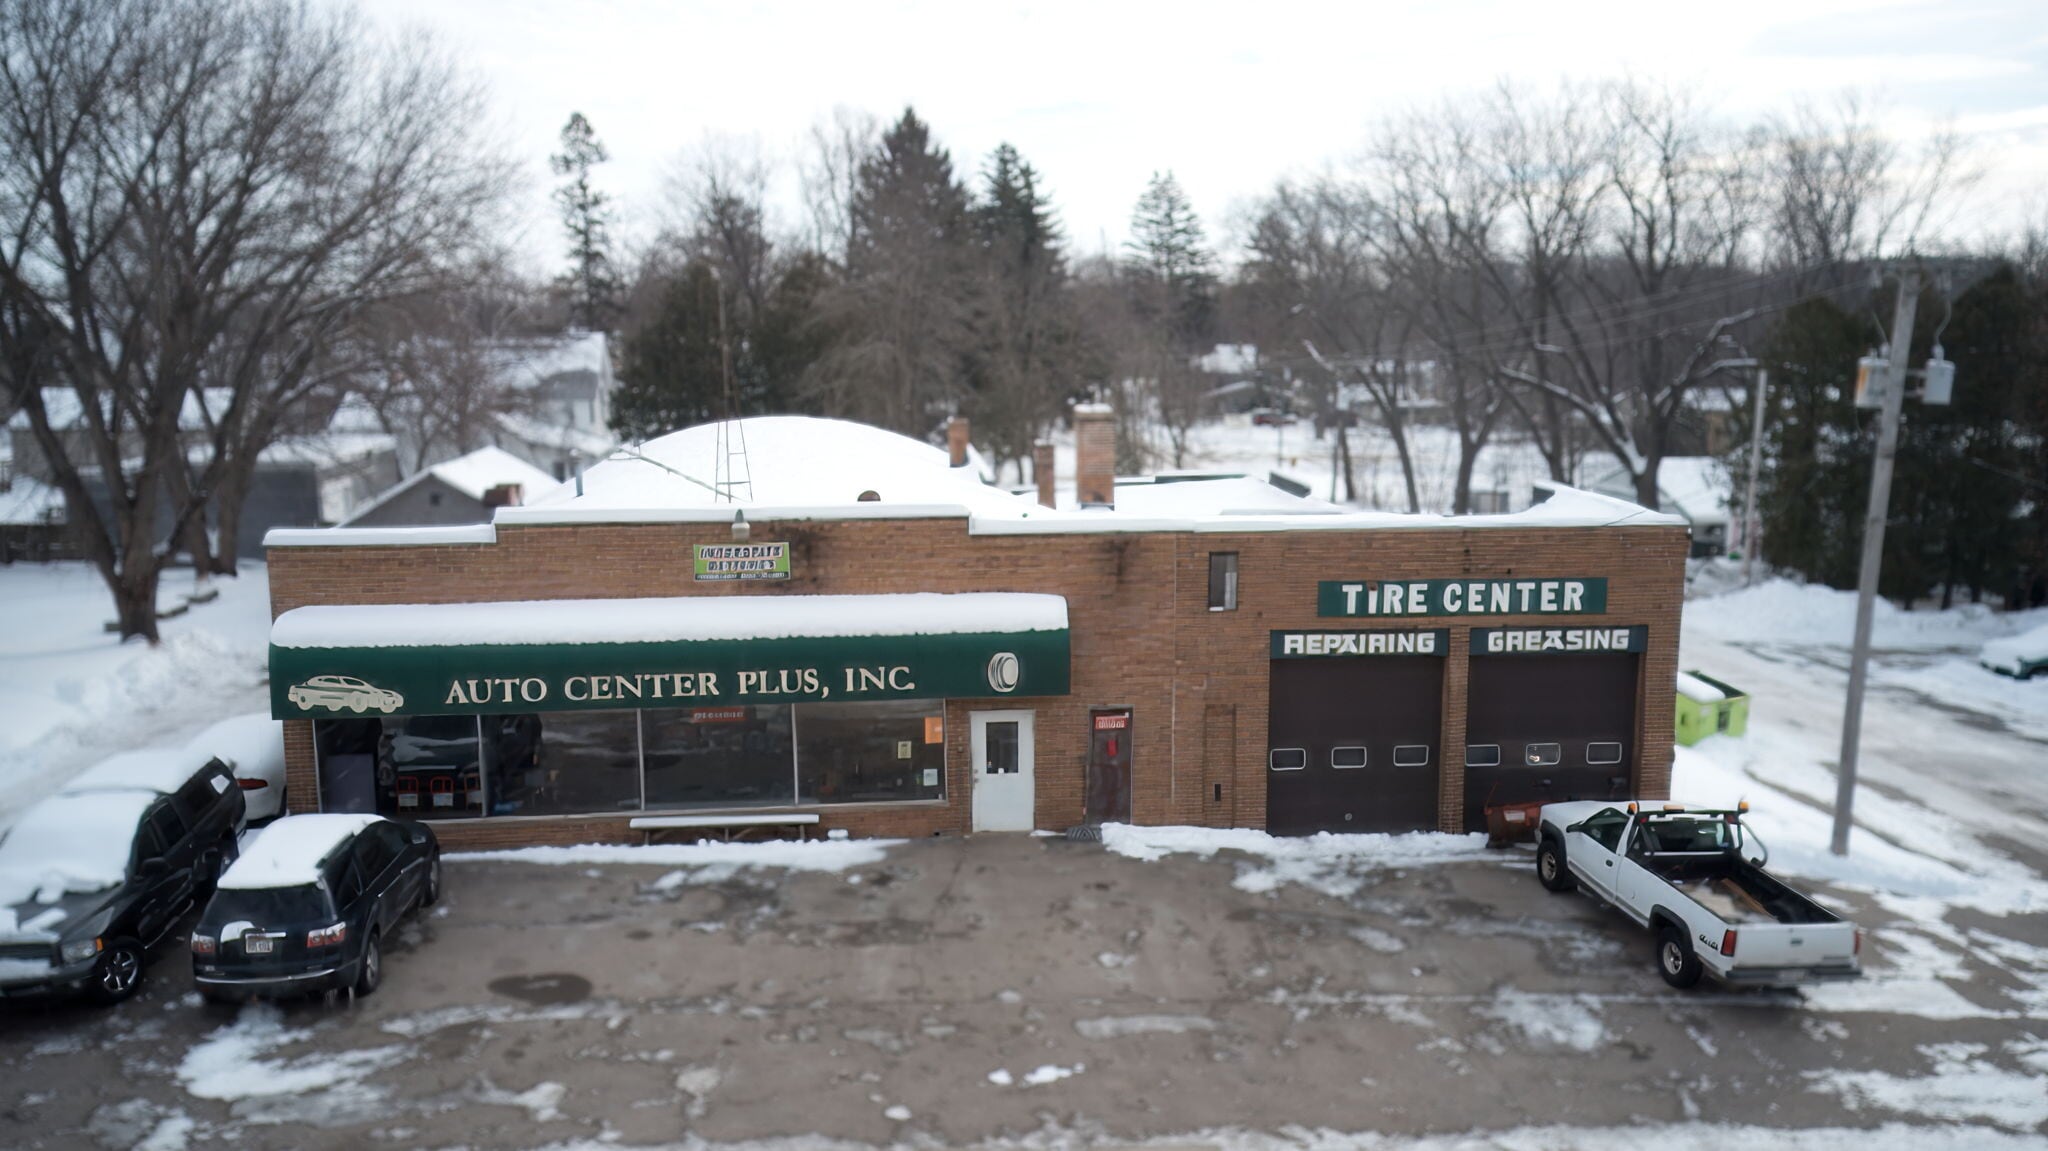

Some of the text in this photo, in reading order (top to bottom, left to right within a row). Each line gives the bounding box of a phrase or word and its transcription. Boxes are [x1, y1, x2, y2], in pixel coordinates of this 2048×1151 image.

[1342, 581, 1584, 614] TIRE CENTER
[1283, 633, 1435, 655] REPAIRING
[1487, 629, 1630, 652] GREASING
[444, 665, 916, 706] AUTO CENTER PLUS, INC.
